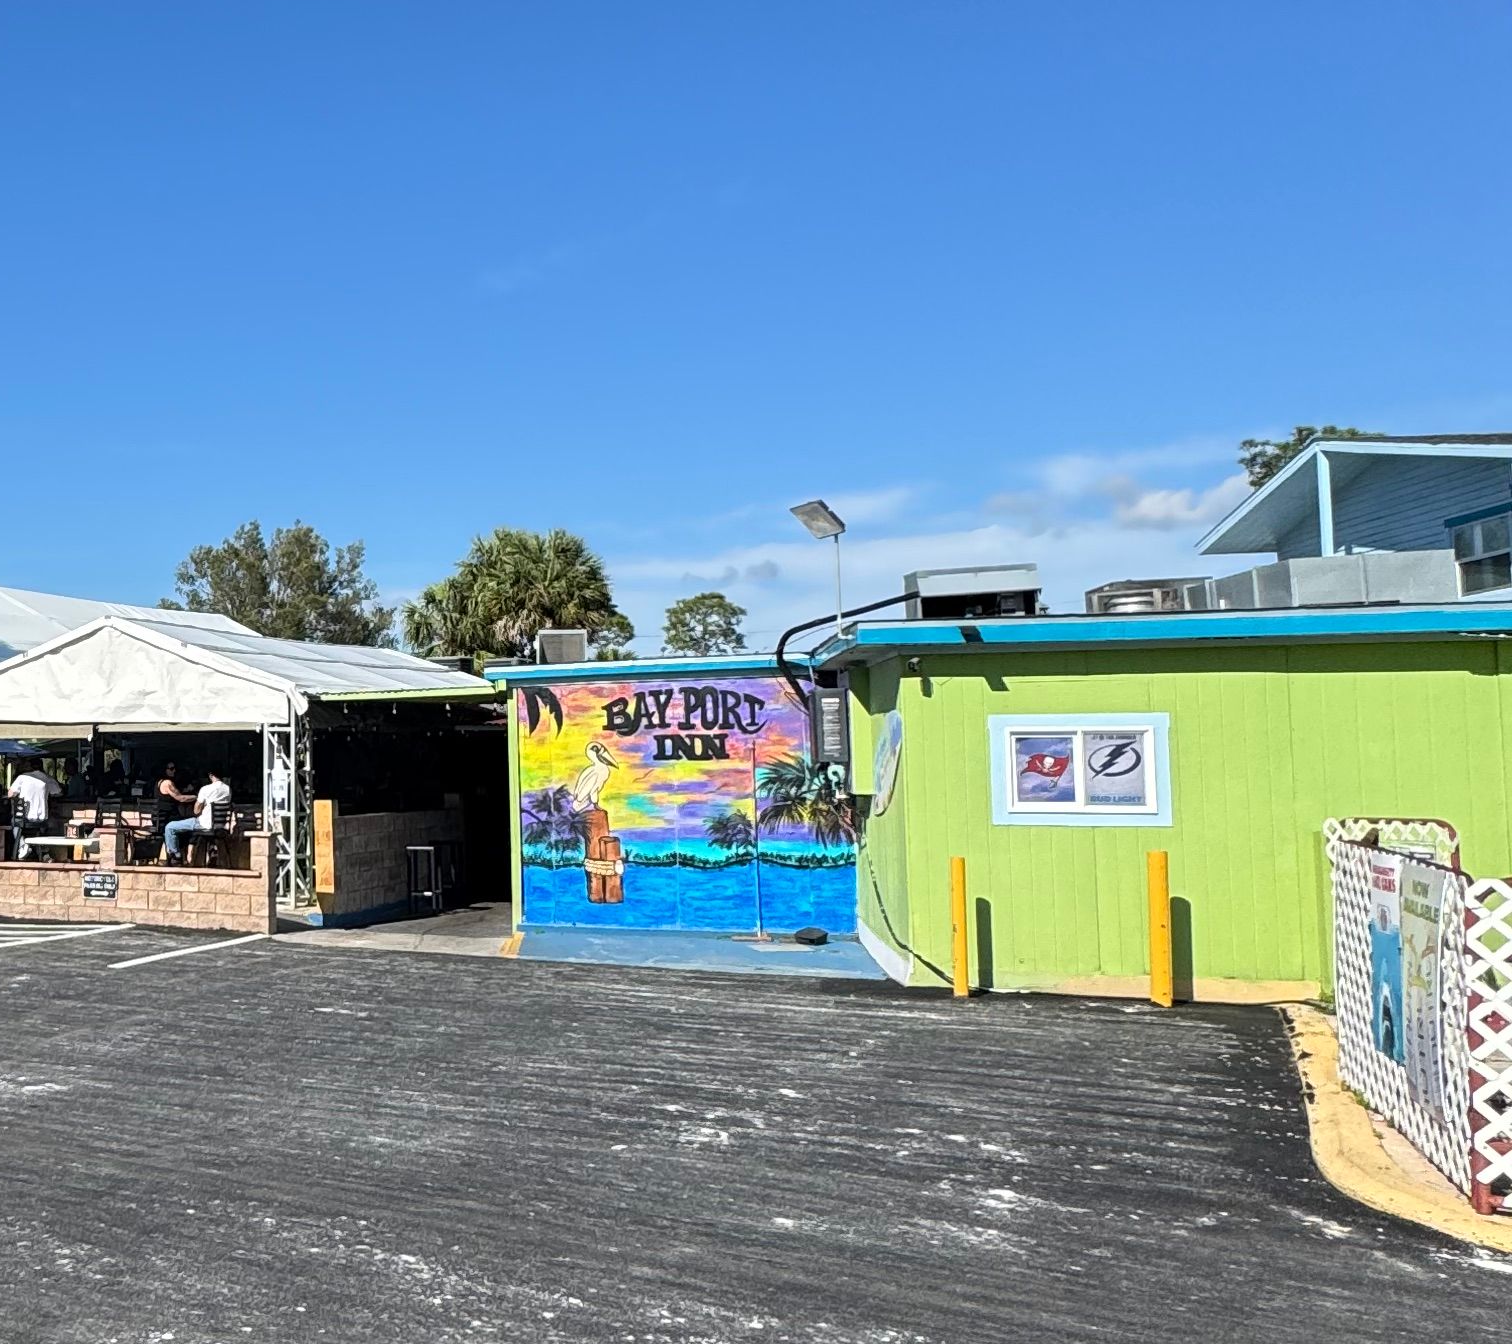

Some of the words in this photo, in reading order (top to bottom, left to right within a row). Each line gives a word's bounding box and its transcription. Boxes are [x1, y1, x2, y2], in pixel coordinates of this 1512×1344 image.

[602, 689, 673, 736] BAY
[678, 686, 768, 734] PORT
[653, 734, 730, 760] INN
